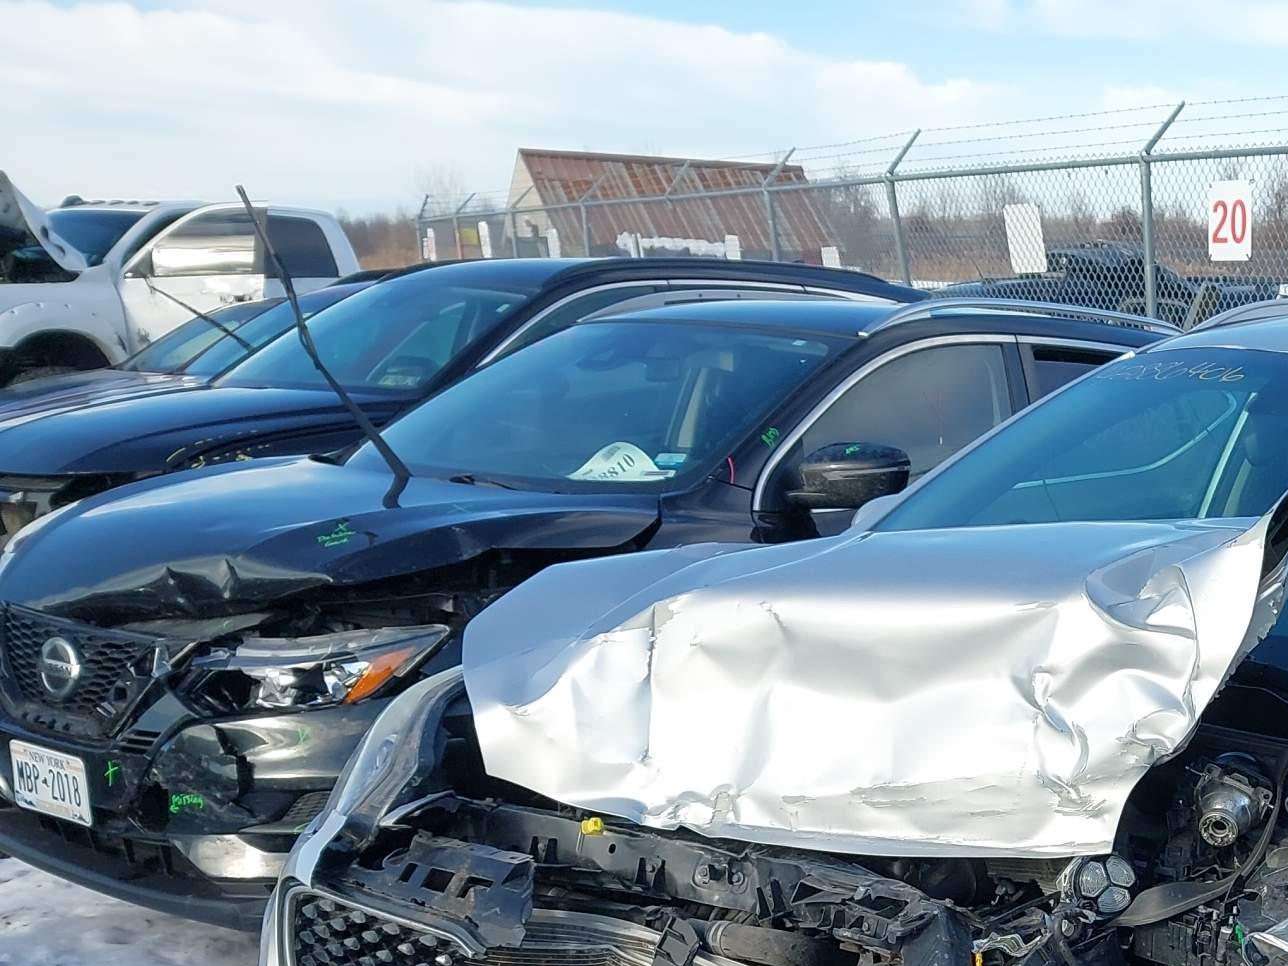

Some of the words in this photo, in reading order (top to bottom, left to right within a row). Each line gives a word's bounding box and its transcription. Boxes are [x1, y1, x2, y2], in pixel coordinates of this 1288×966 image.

[1212, 199, 1247, 244] 20
[28, 751, 45, 763] NEW
[46, 756, 66, 771] YORK
